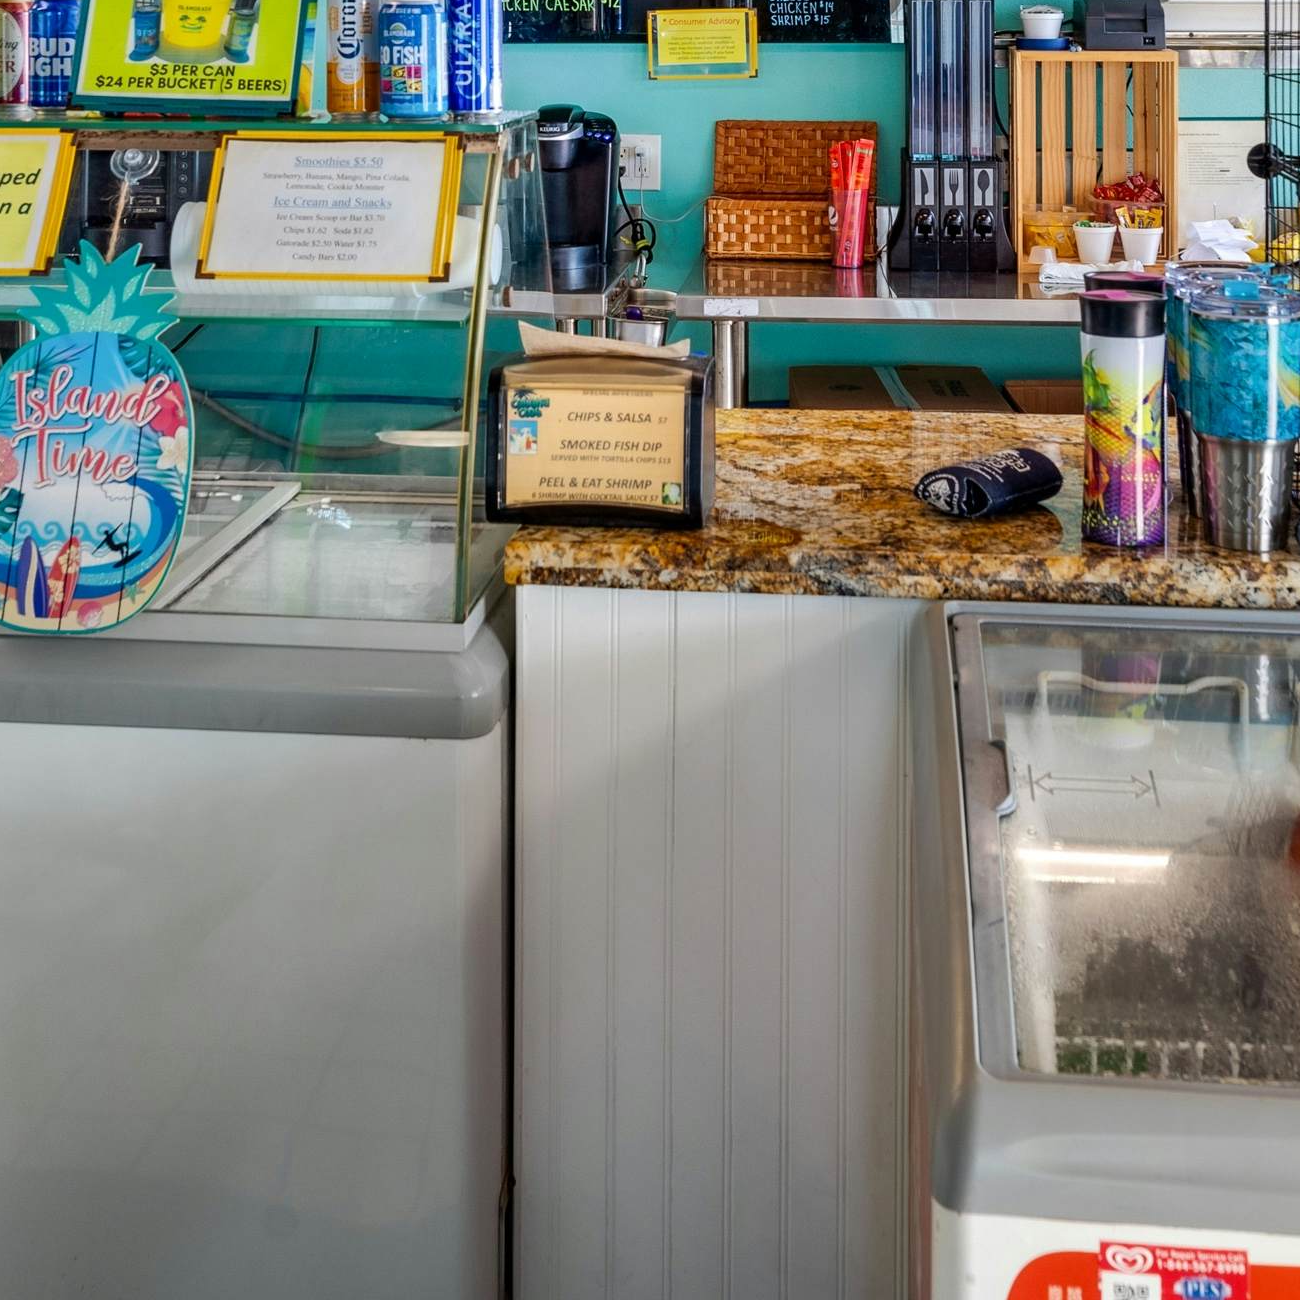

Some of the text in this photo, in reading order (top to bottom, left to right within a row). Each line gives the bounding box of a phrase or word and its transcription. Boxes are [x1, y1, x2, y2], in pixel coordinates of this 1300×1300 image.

[770, 1, 834, 14] CHICKEN $14
[771, 14, 830, 26] SHRIMP $15
[30, 38, 75, 56] BUD
[456, 3, 472, 85] ULTRA
[393, 46, 423, 64] FISH
[150, 65, 235, 76] $5 PER CAN
[95, 76, 287, 94] $24 PER BUCKET (5 BEERS)
[294, 156, 383, 168] Smoothies $5.50
[18, 202, 32, 215] a
[274, 196, 392, 209] Ice Cream and Snacks
[9, 364, 171, 429] Island
[567, 412, 652, 423] CHIPS & SALSA
[560, 440, 662, 451] SMOKED FISH DIP
[10, 422, 139, 488] Time
[540, 477, 652, 489] PEEL & EAT SHRIMP
